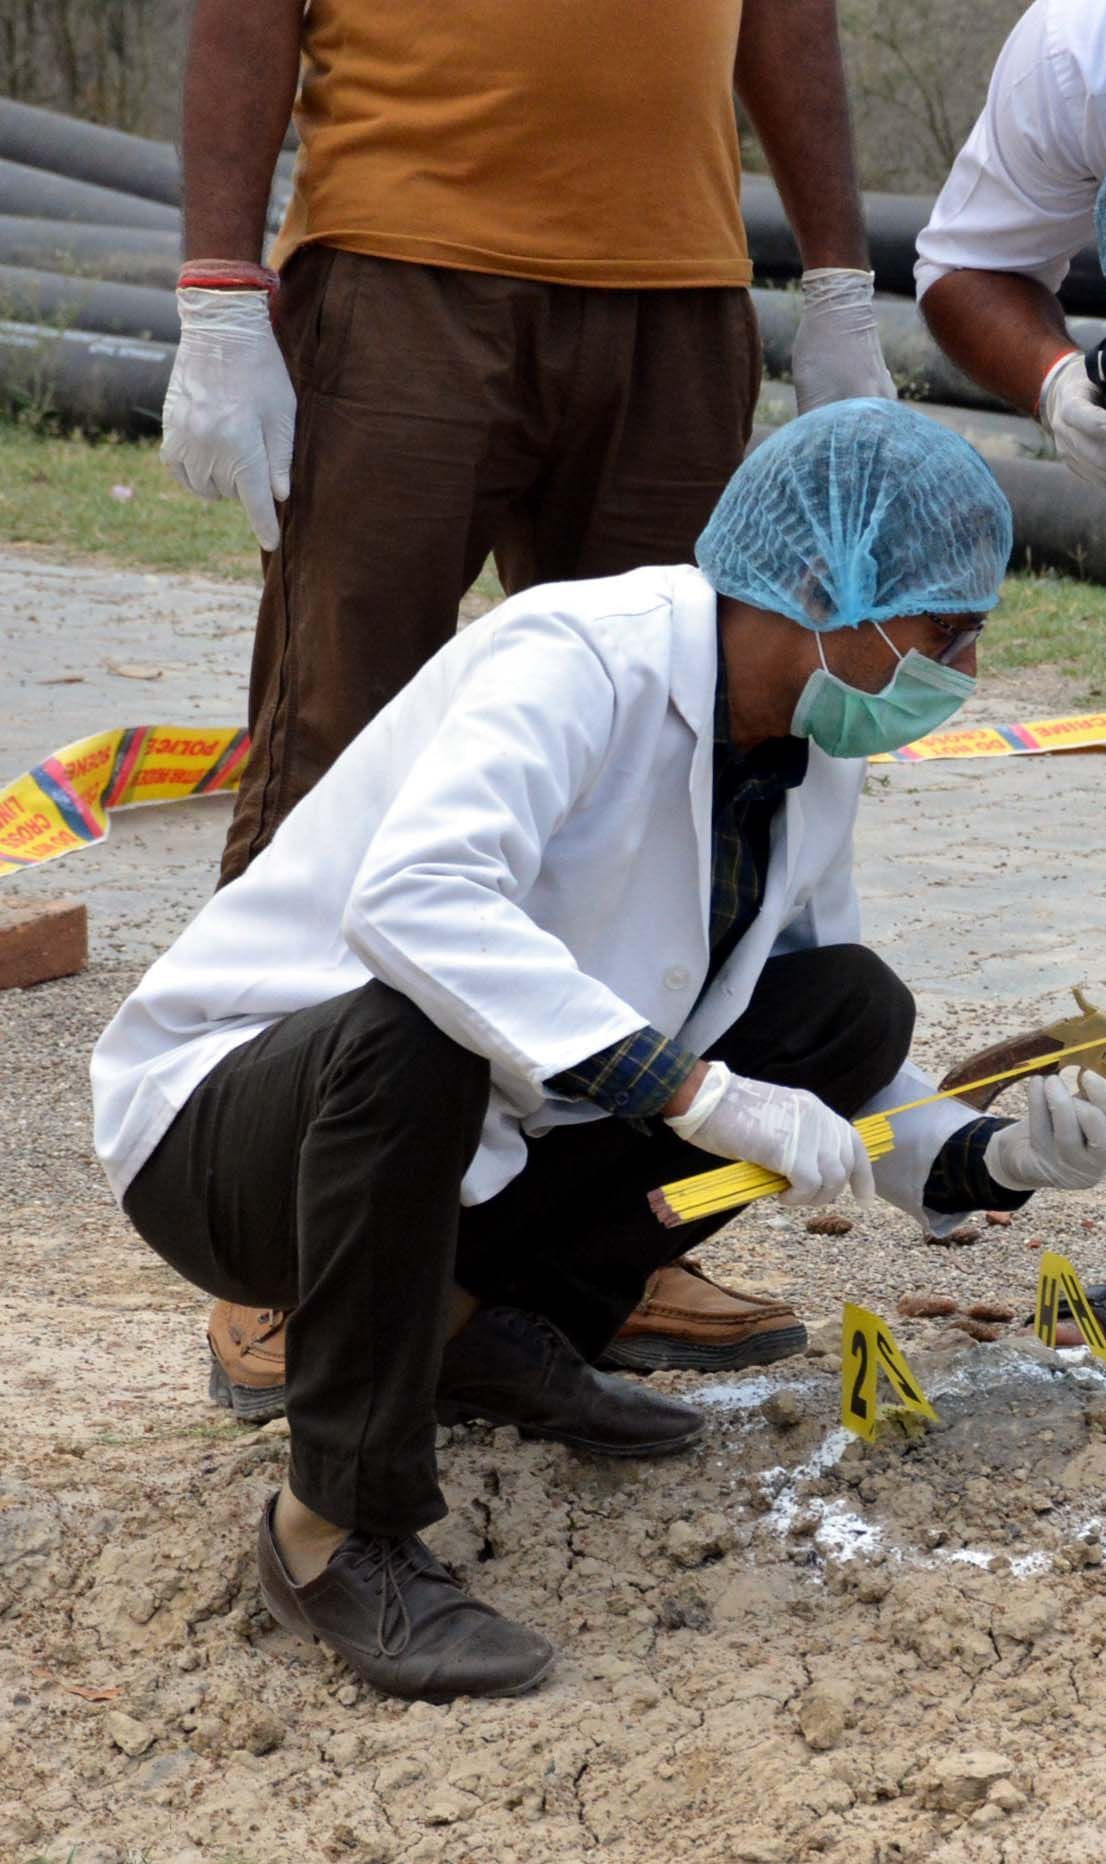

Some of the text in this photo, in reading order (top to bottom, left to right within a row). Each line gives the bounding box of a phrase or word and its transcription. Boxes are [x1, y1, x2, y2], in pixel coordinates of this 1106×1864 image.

[144, 737, 219, 756] POLICE
[0, 795, 25, 830] LIN
[851, 1329, 868, 1420] 2
